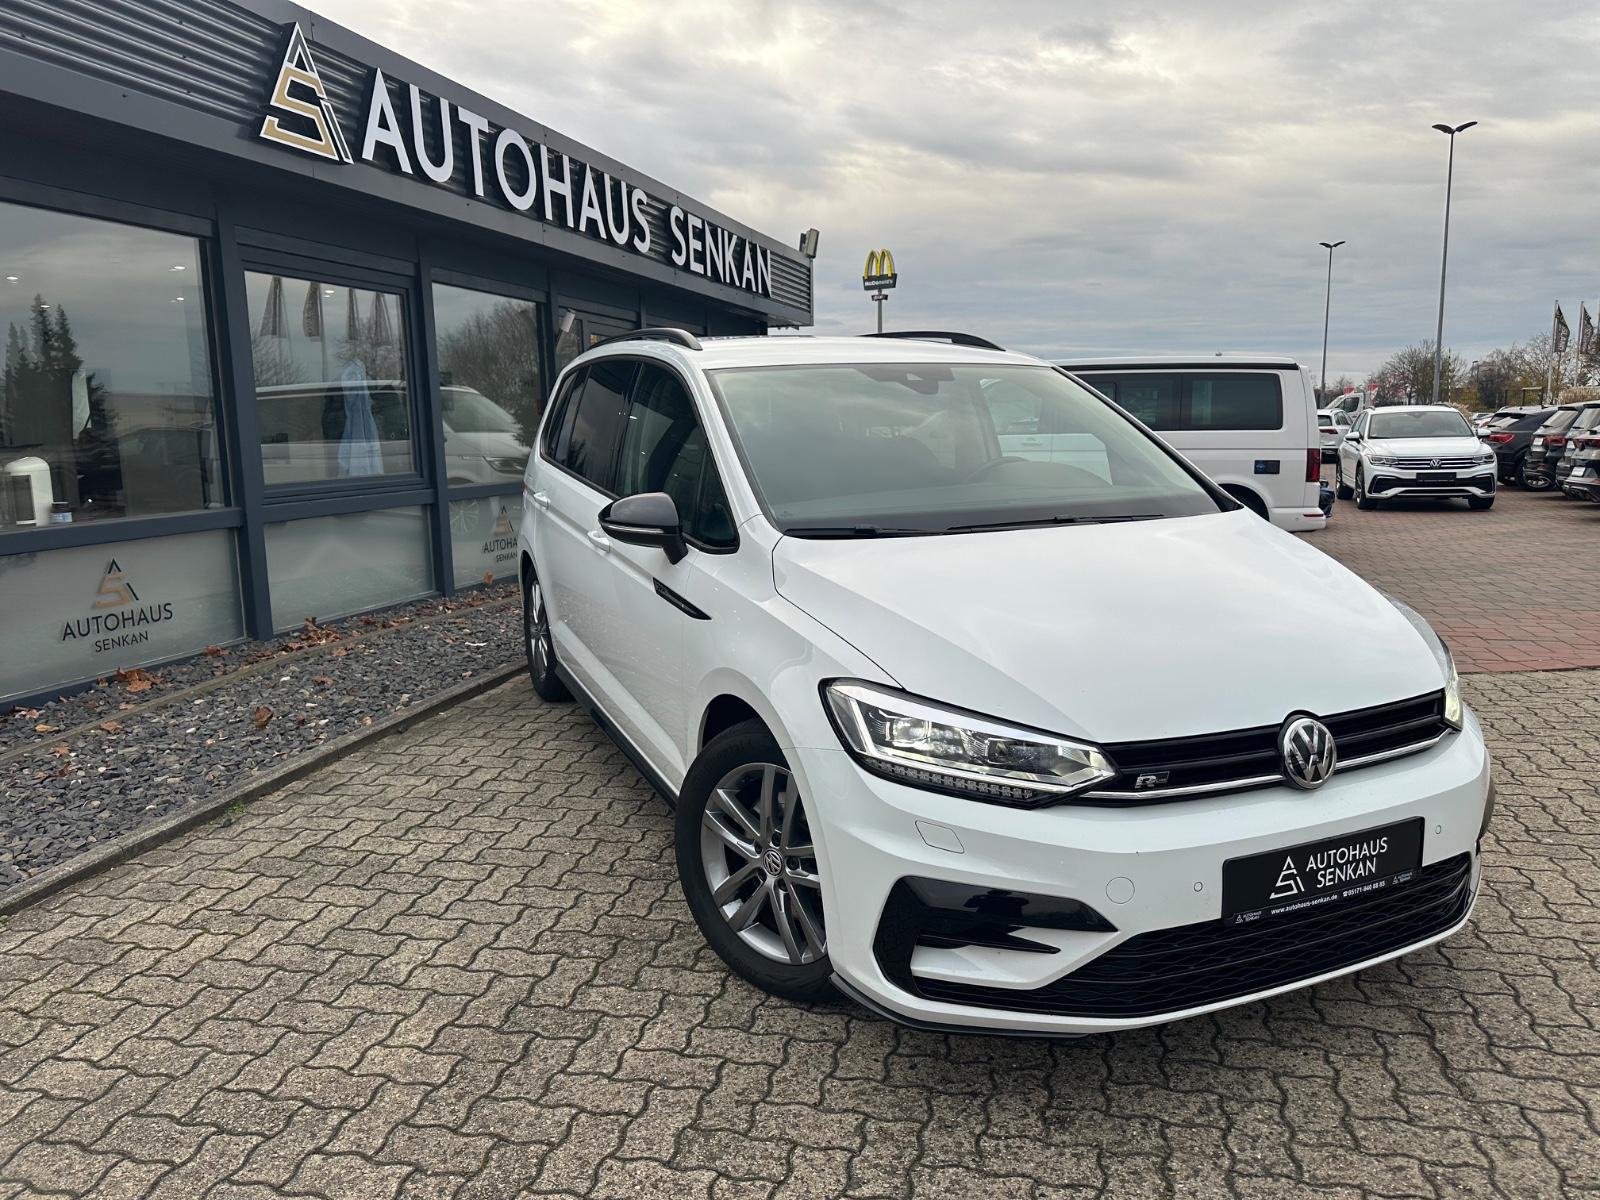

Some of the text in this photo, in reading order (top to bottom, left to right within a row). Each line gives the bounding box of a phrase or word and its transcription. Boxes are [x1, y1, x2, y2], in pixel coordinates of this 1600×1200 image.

[361, 67, 773, 298] AUTOHAUS SENKAN
[483, 537, 518, 553] AUTOHA
[62, 603, 174, 641] AUTOHAUS
[95, 630, 149, 653] SENKAN
[1306, 836, 1388, 872] AUTOHAUS
[1316, 857, 1377, 888] SENKAN
[1271, 894, 1338, 915] www.autohaus-senkan.de
